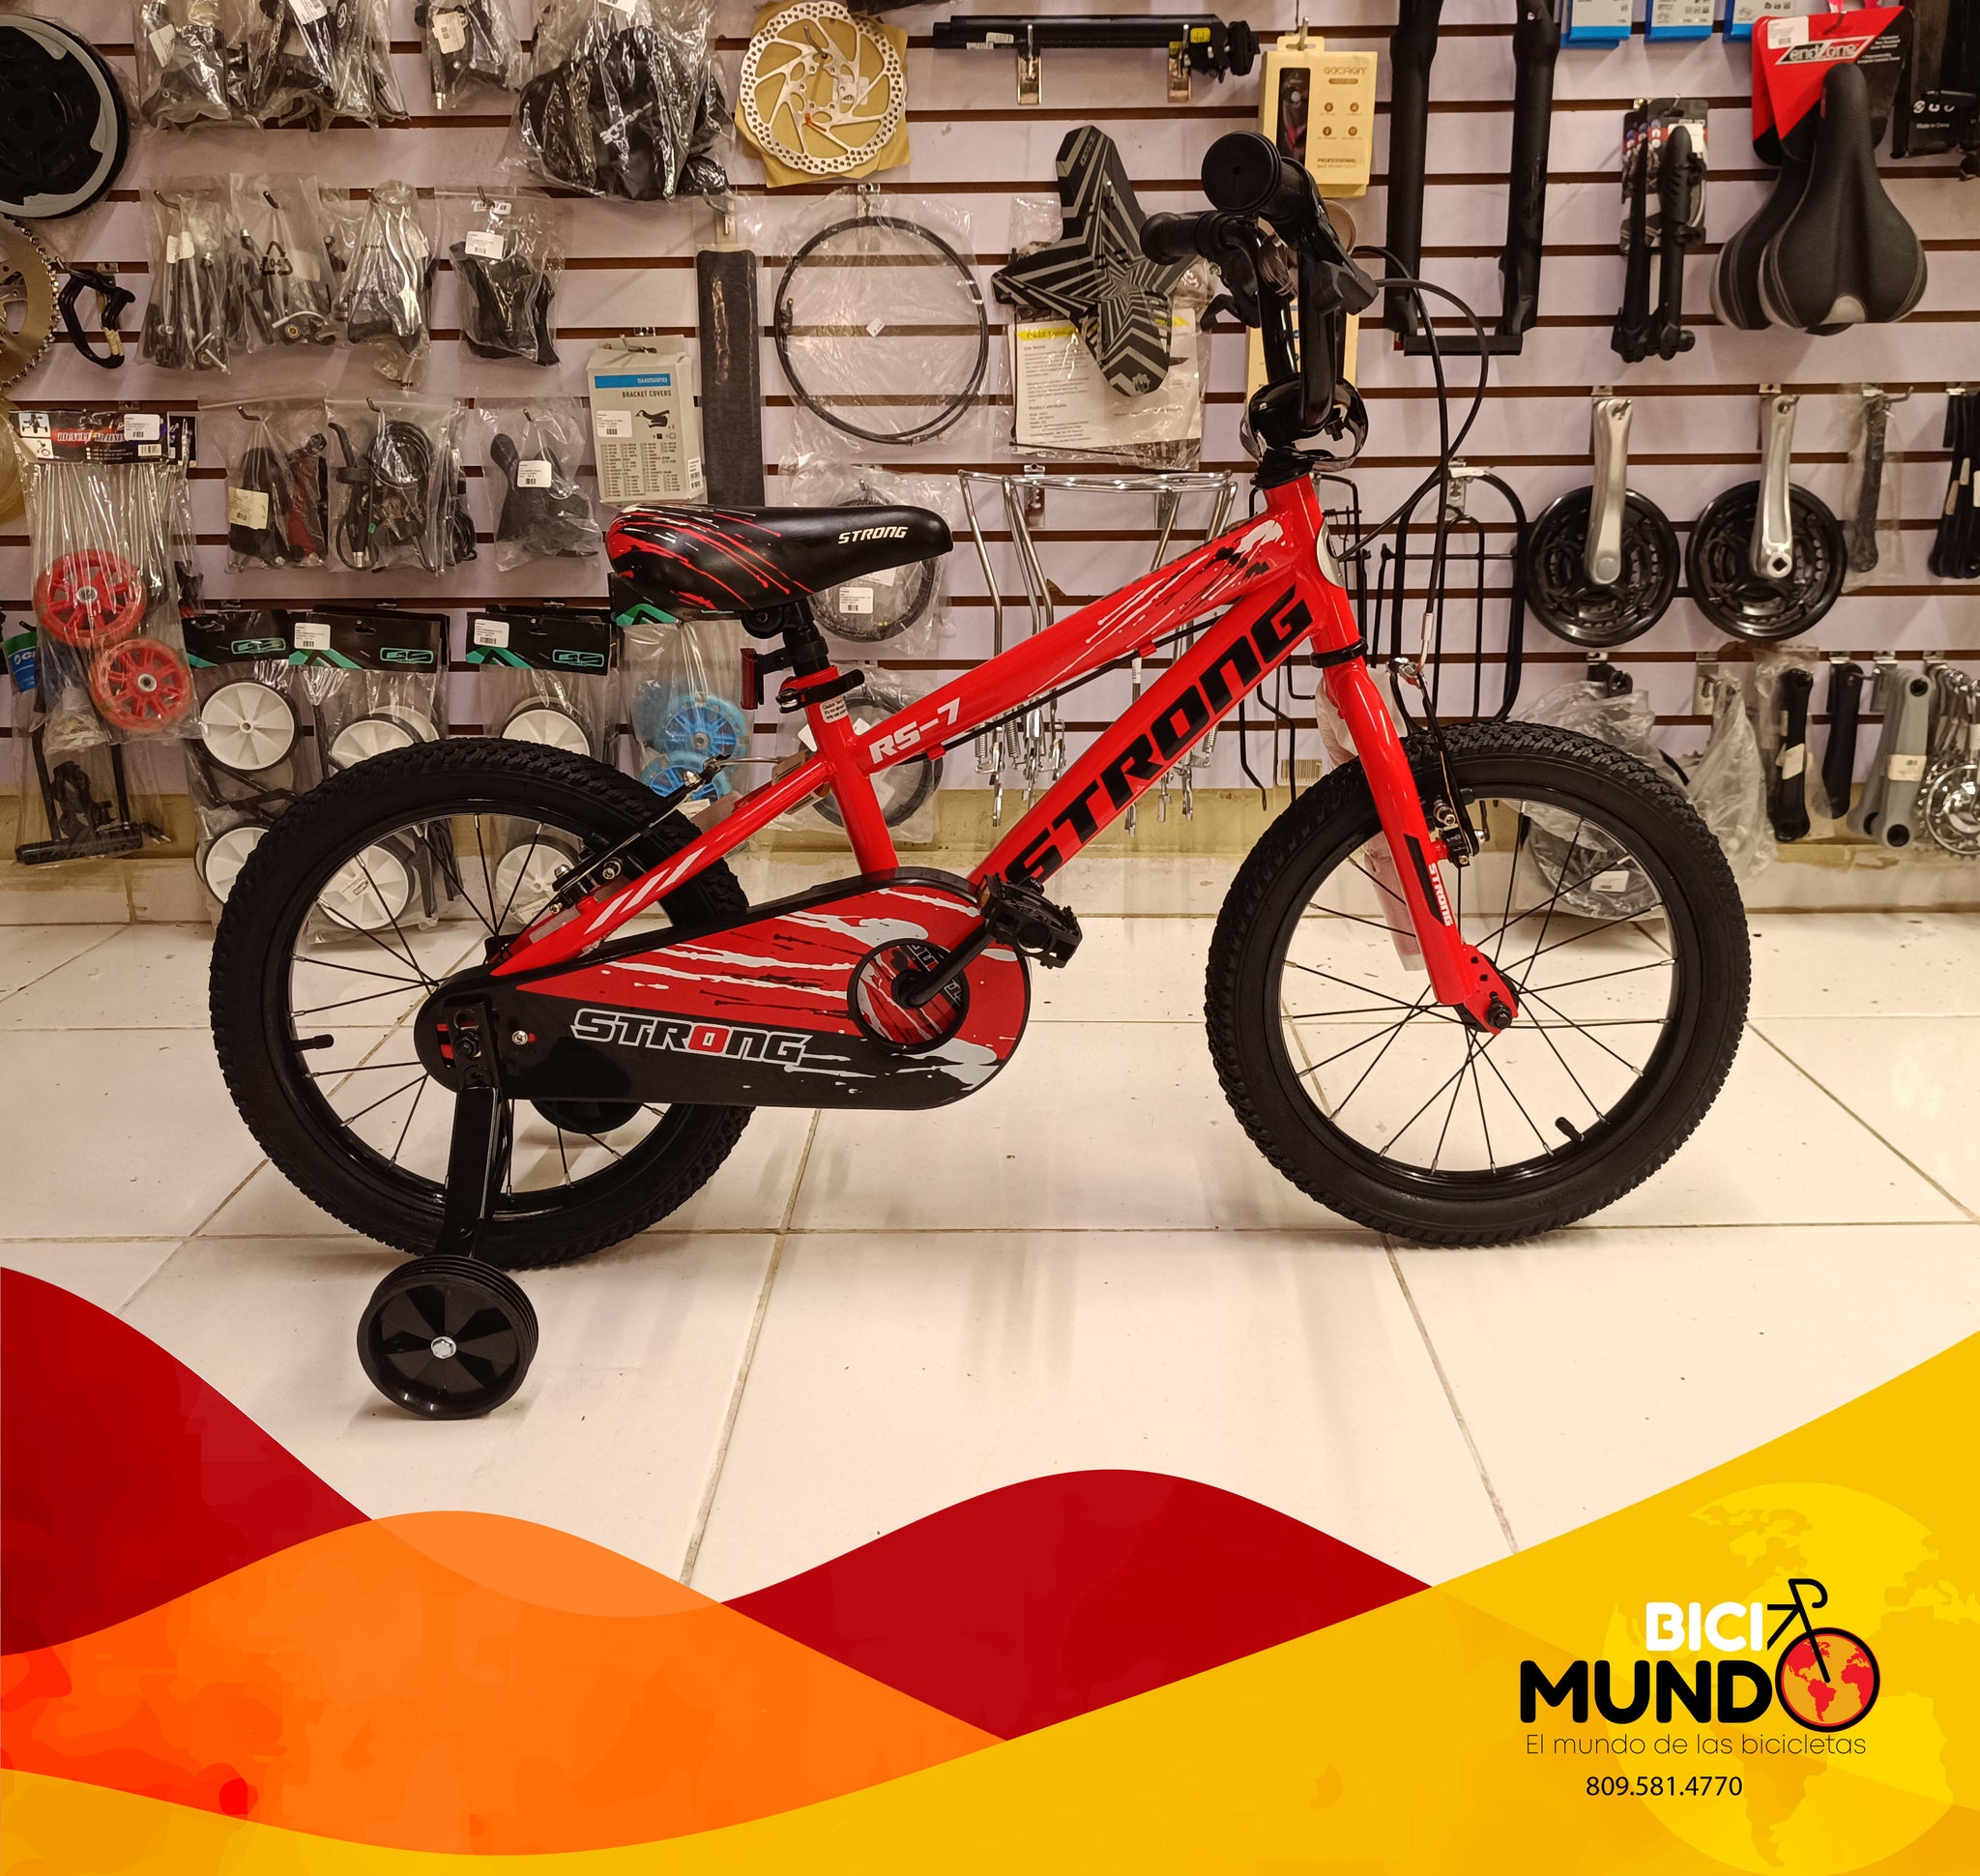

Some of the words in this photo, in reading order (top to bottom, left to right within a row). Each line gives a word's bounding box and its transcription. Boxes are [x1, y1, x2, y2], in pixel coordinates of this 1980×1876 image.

[649, 389, 672, 397] COVERS
[838, 526, 909, 544] STRONG
[869, 697, 960, 764] RS-7
[1005, 583, 1313, 883] STRONG
[1429, 862, 1454, 926] STRONG
[570, 1008, 813, 1067] STRONG
